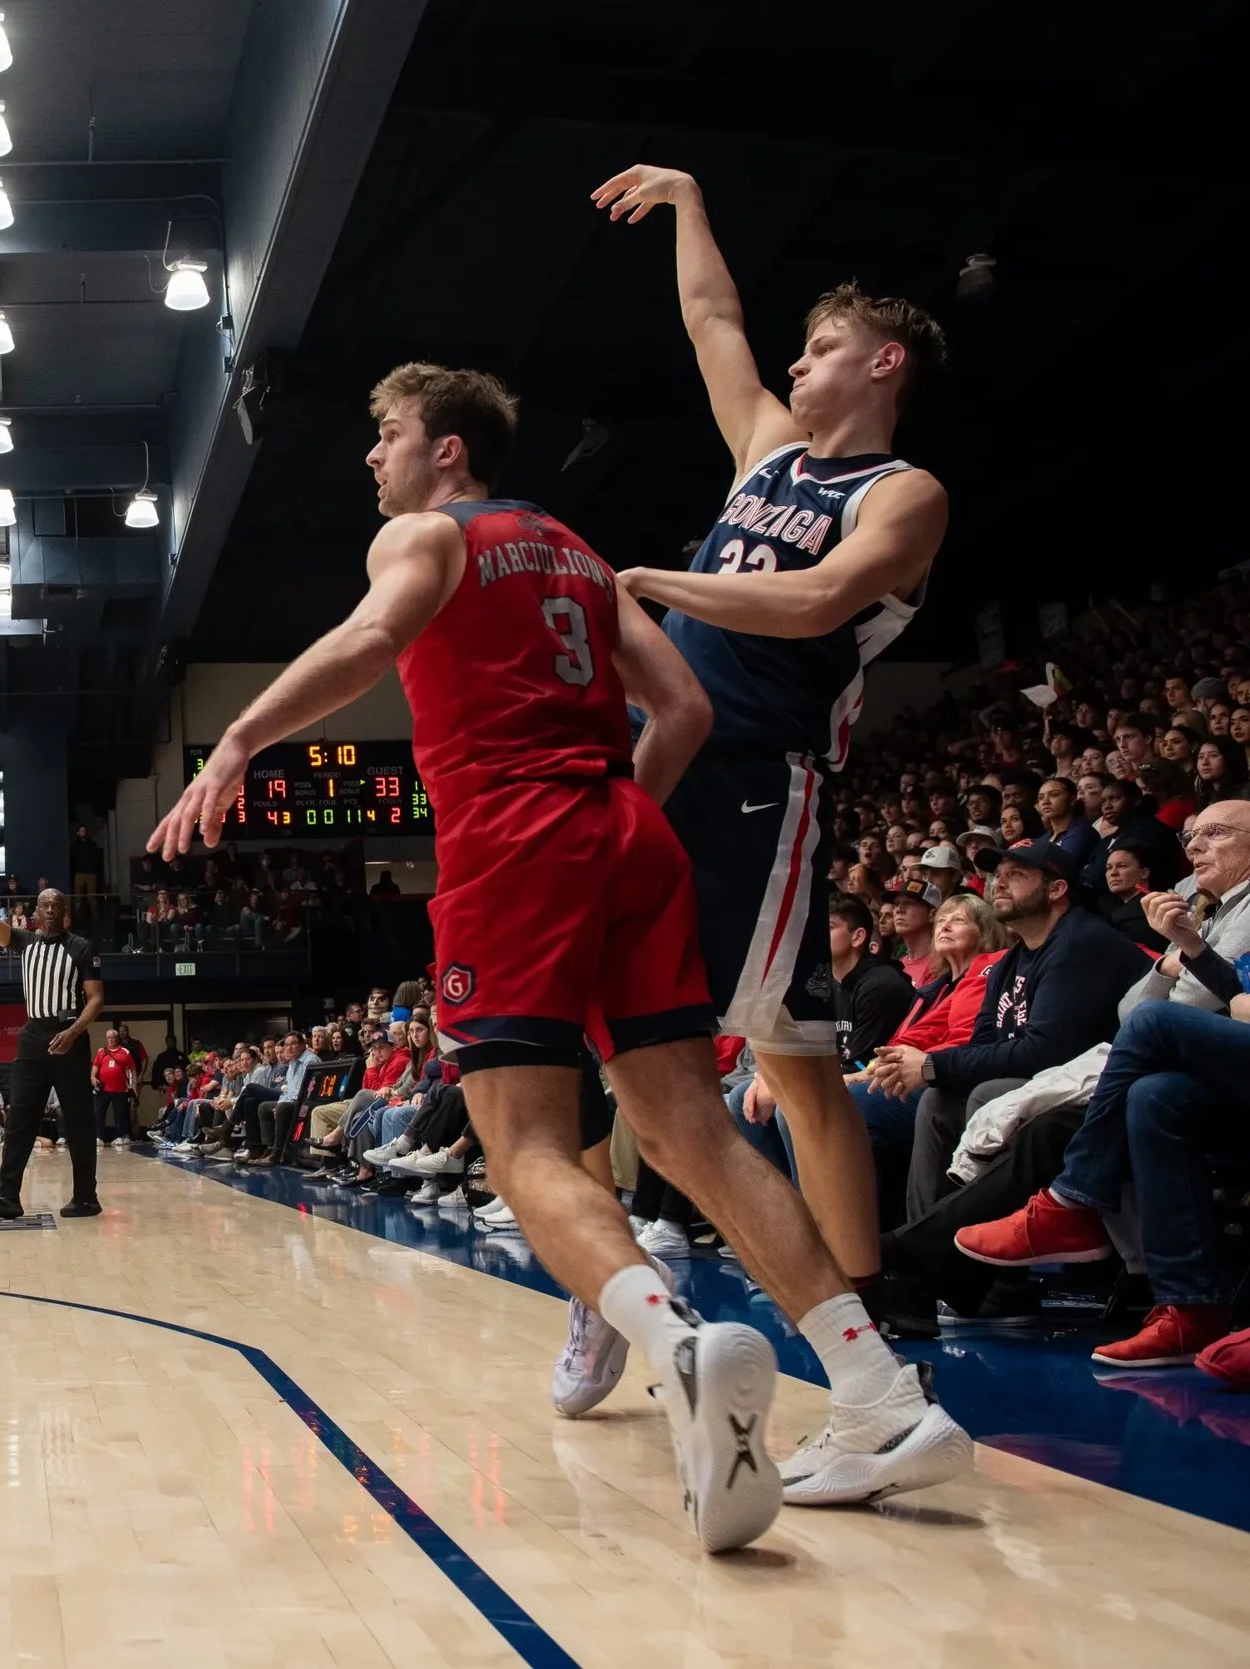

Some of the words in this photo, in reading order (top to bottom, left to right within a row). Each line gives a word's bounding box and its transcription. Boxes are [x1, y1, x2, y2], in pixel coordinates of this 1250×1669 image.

[718, 493, 833, 556] GONZAGA
[541, 596, 595, 687] 3
[309, 745, 356, 766] 5:10
[253, 769, 285, 778] HOME
[367, 766, 404, 776] GUEST
[268, 780, 286, 798] 19
[329, 779, 334, 797] 1
[375, 777, 400, 797] 33
[267, 811, 278, 825] 4
[283, 811, 291, 824] 3
[367, 810, 376, 821] 4
[391, 807, 401, 823] 2
[412, 807, 427, 819] 34
[996, 991, 1014, 1029] SAINT
